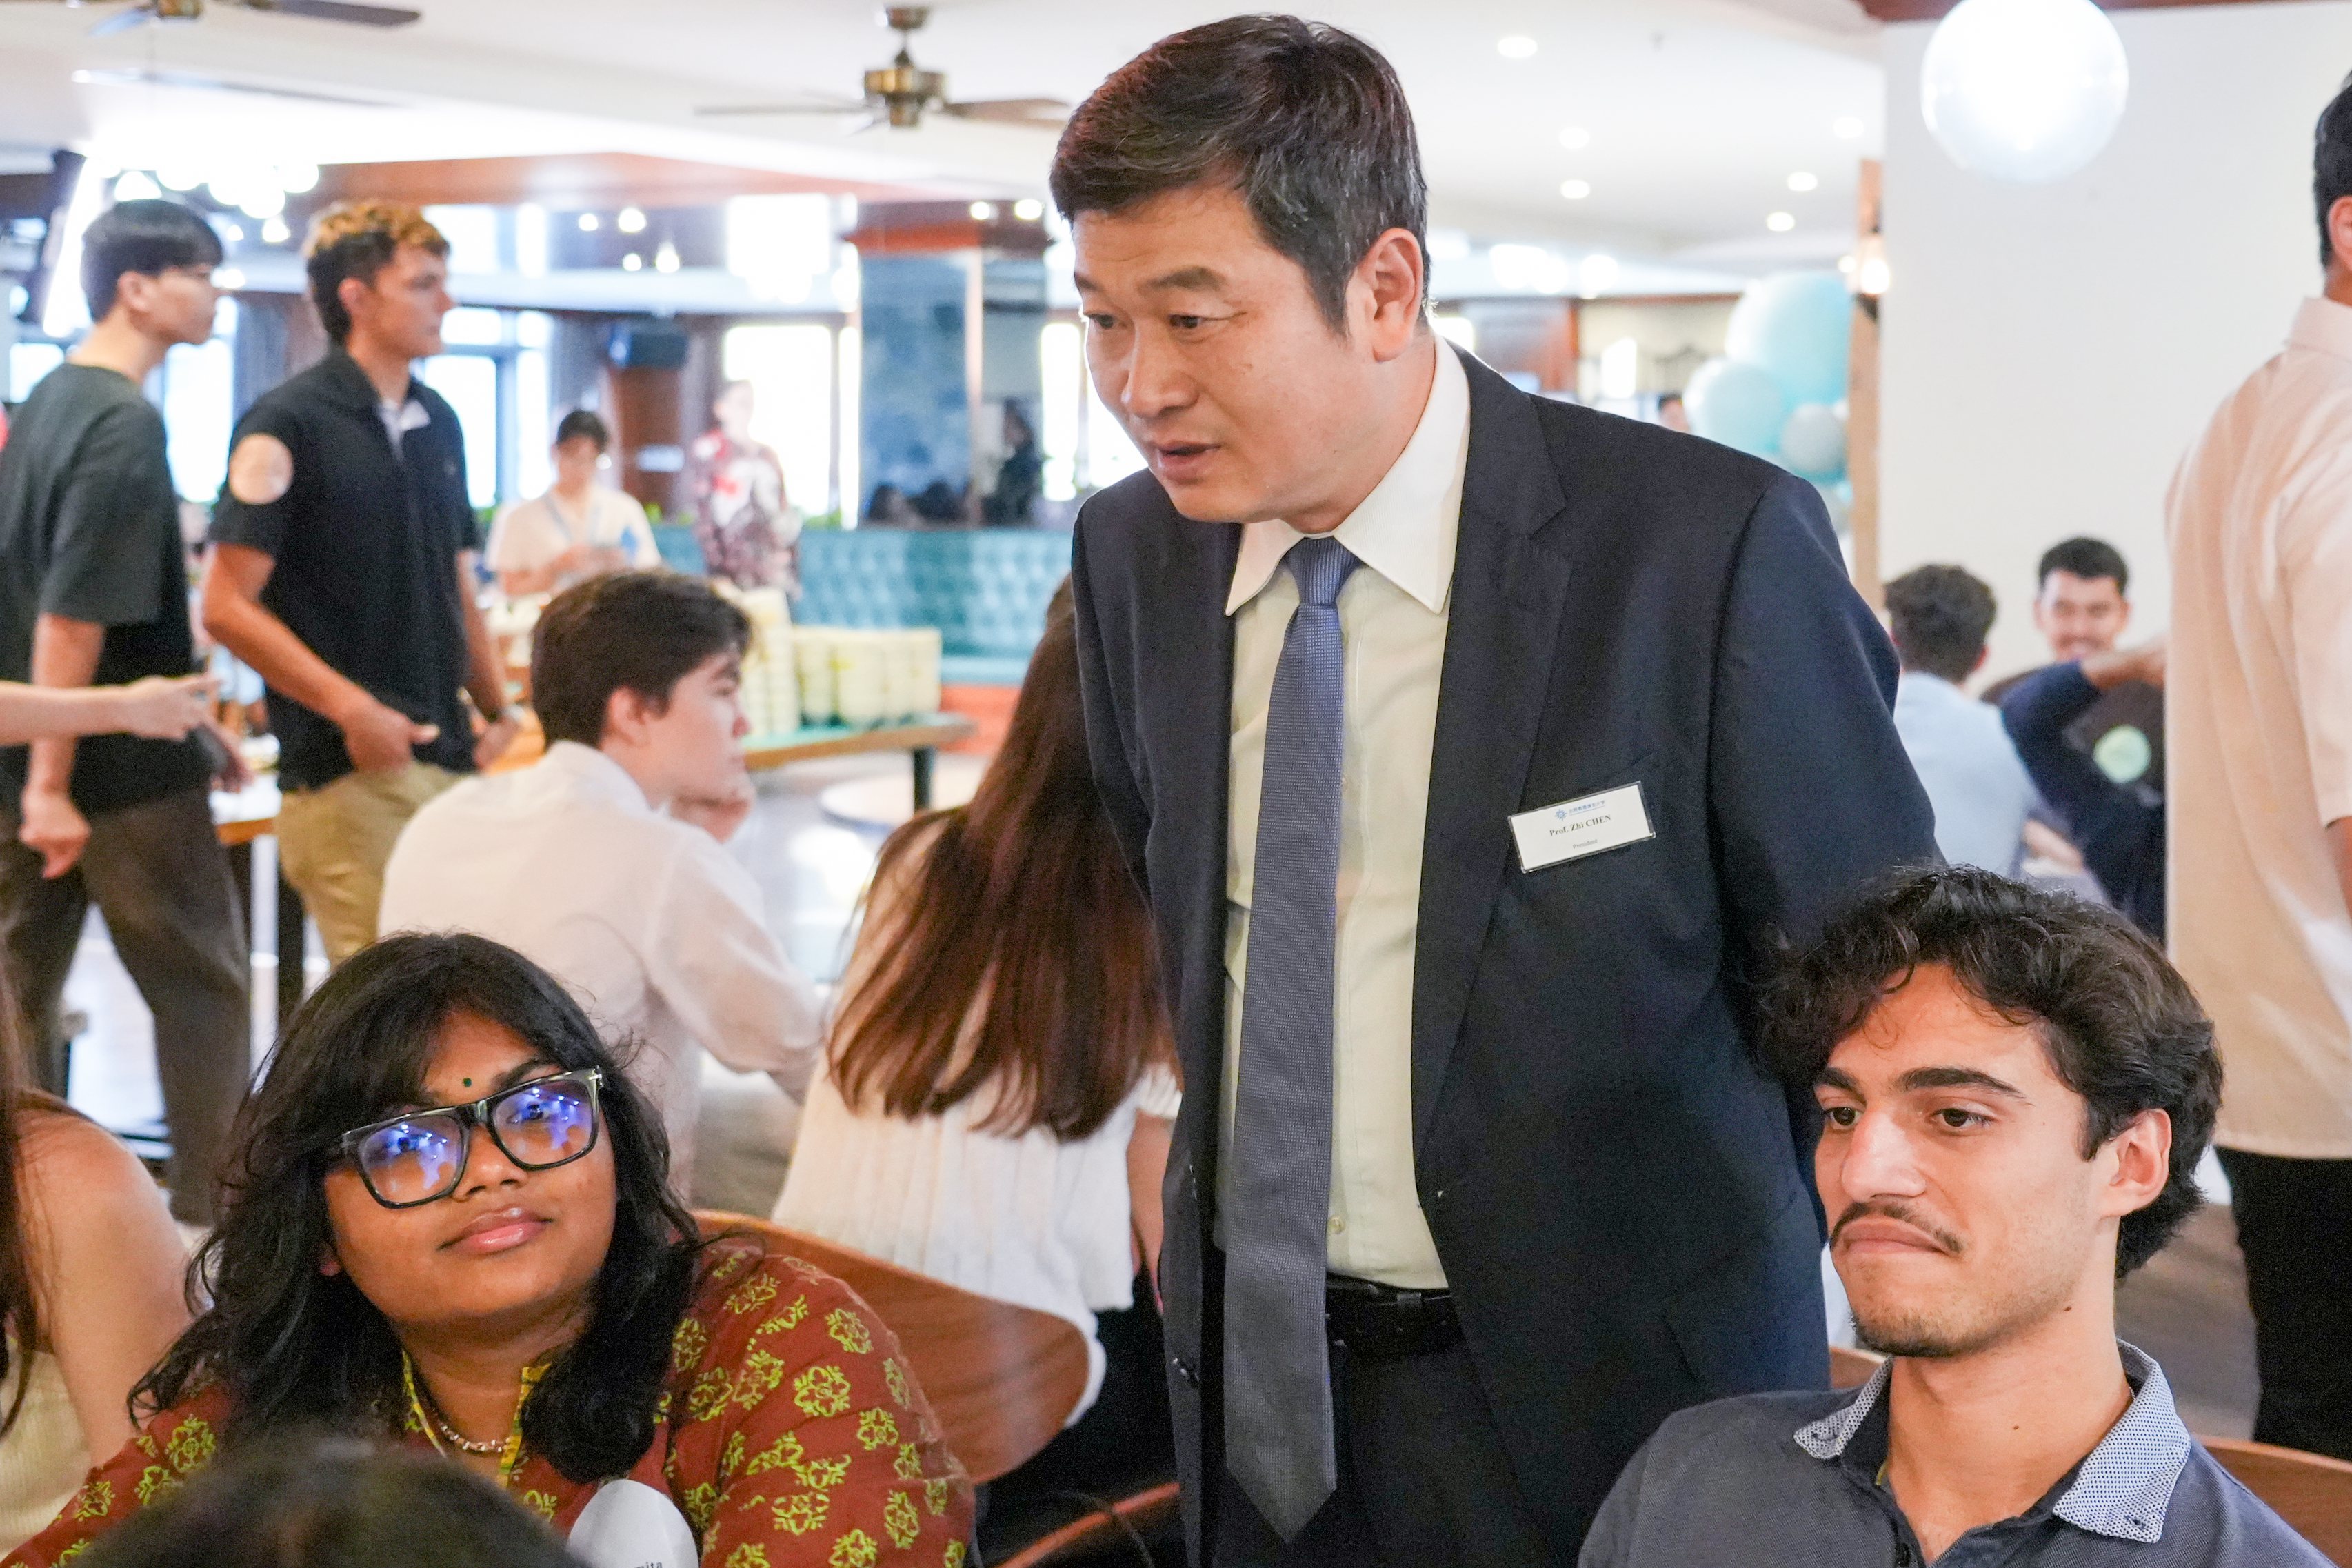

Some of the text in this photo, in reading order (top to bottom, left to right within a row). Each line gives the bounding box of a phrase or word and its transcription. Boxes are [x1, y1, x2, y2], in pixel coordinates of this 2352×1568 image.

[1549, 814, 1611, 836] Prof. Zhi CHEN
